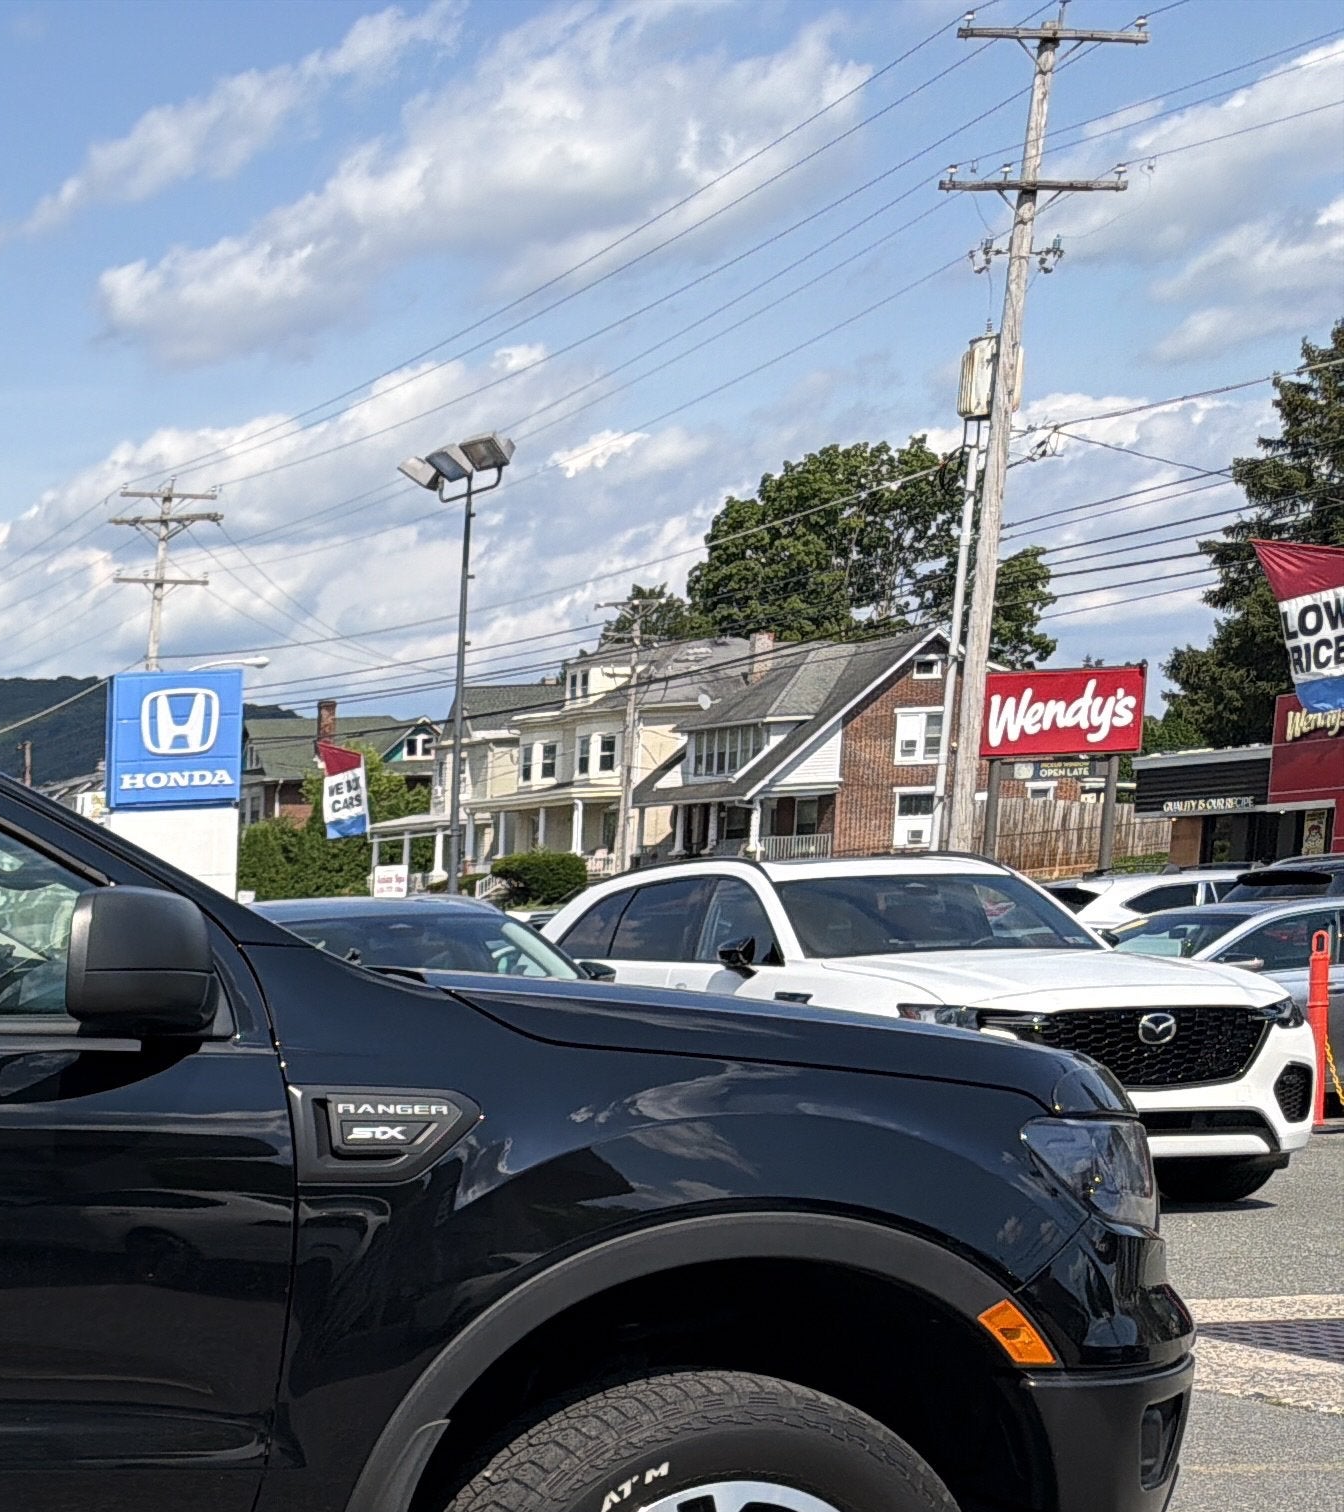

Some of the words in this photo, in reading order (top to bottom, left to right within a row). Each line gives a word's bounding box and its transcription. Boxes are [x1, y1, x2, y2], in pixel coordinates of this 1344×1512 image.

[988, 678, 1136, 747] Wendy's
[1040, 768, 1065, 777] OPEN
[1067, 766, 1089, 776] LATE
[120, 770, 234, 790] HONDA
[332, 794, 362, 813] CARS
[1206, 797, 1224, 809] OUR
[337, 1103, 449, 1115] RANGER
[347, 1126, 408, 1140] STX
